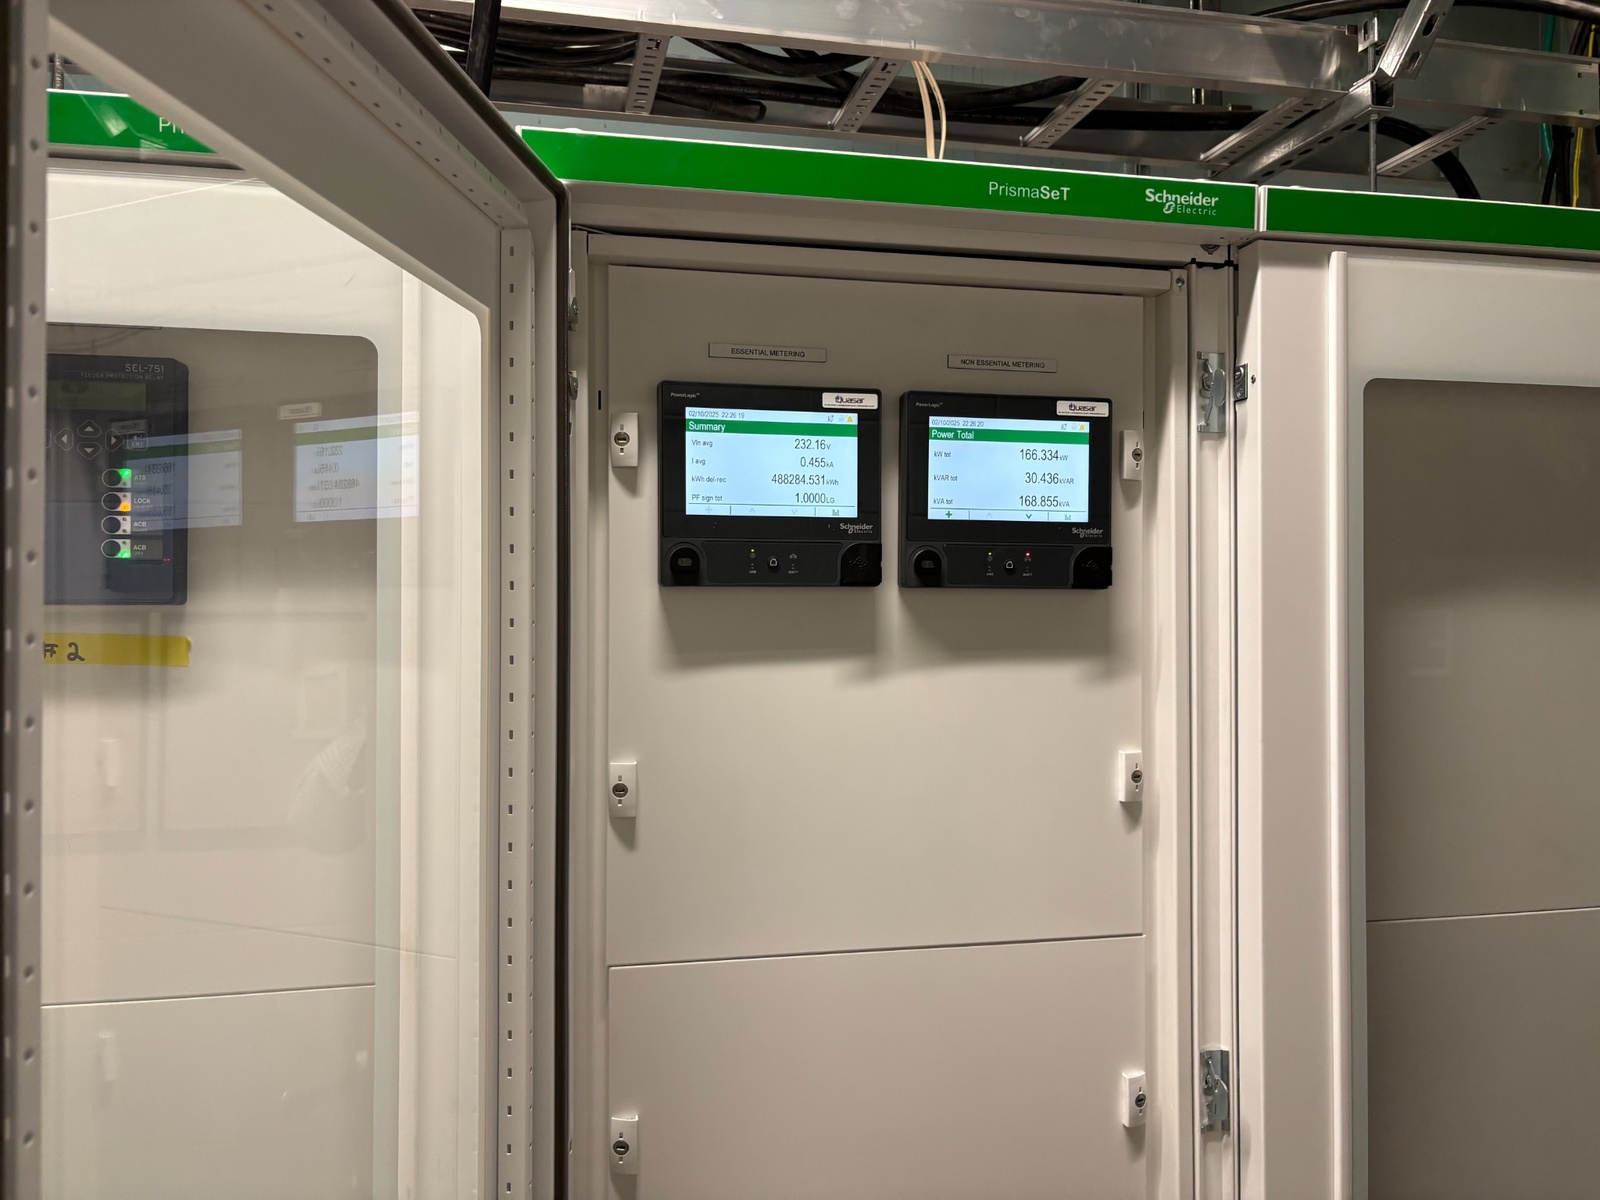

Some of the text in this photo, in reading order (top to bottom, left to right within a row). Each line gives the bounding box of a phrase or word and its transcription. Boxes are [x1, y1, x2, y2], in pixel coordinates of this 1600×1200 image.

[988, 181, 1070, 201] PrismaSeT
[1145, 188, 1219, 208] Schneider
[1176, 204, 1217, 216] Electric
[731, 347, 805, 358] ESSENTIAL METERING
[125, 363, 165, 373] SEL-751
[960, 358, 1045, 369] NON ESSENTIAL METERING
[688, 410, 719, 419] 02/10/2025
[688, 421, 726, 433] Summary
[931, 419, 960, 427] 02/10/2025
[931, 429, 975, 440] Power Total
[702, 440, 713, 448] avg
[695, 458, 706, 467] avg
[691, 475, 705, 483] kWh
[933, 474, 958, 482] kVAR tot
[701, 494, 714, 503] sign
[714, 494, 723, 502] tot
[840, 523, 873, 531] Schneider
[1072, 527, 1103, 536] Schneider
[67, 641, 86, 662] 2
